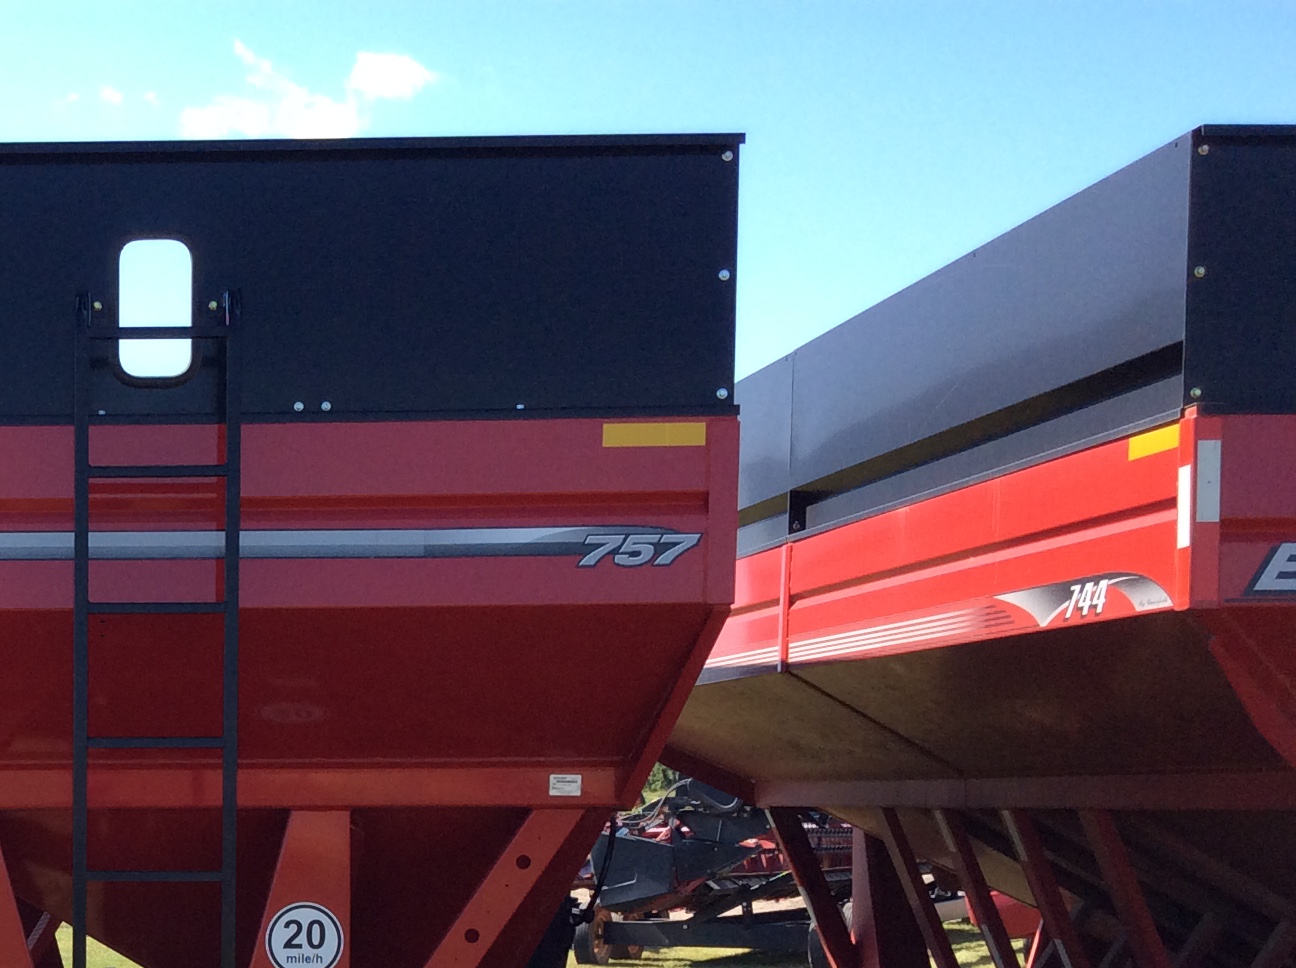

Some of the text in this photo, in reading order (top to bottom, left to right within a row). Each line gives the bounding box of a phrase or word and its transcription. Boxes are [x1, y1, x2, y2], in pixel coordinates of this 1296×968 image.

[577, 533, 702, 567] 757
[1063, 578, 1109, 621] 744
[282, 919, 326, 950] 20
[286, 953, 324, 964] mile/h
